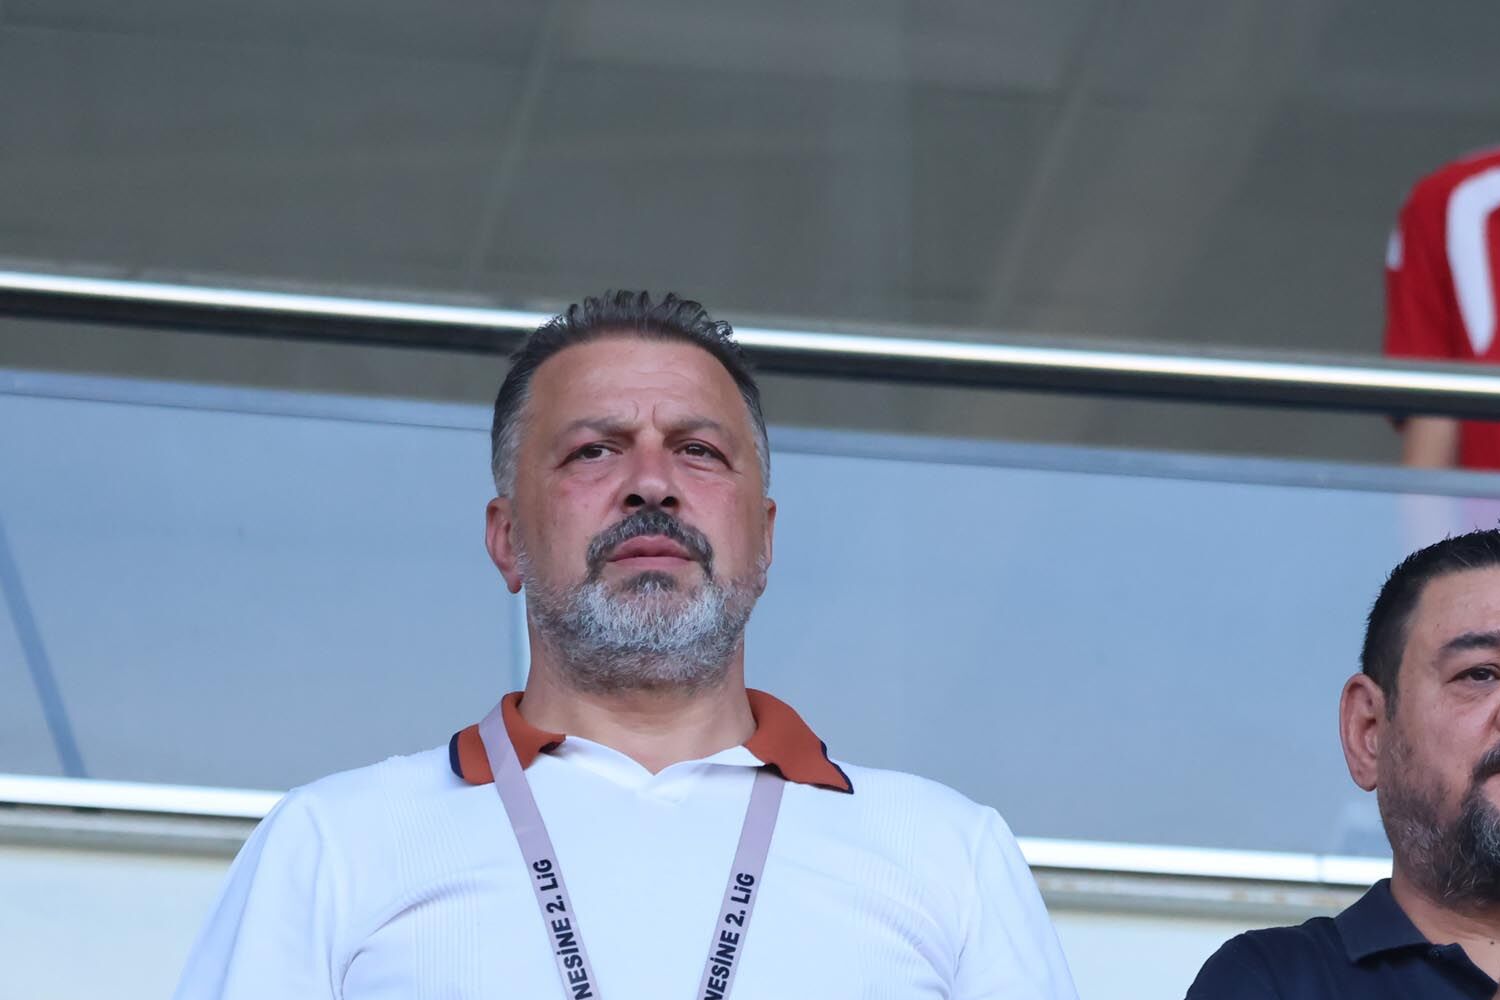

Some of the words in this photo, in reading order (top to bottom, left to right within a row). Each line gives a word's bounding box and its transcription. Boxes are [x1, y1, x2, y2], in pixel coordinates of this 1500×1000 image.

[546, 894, 566, 914] 2.
[725, 910, 746, 927] 2.
[551, 917, 593, 1000] NESİNE
